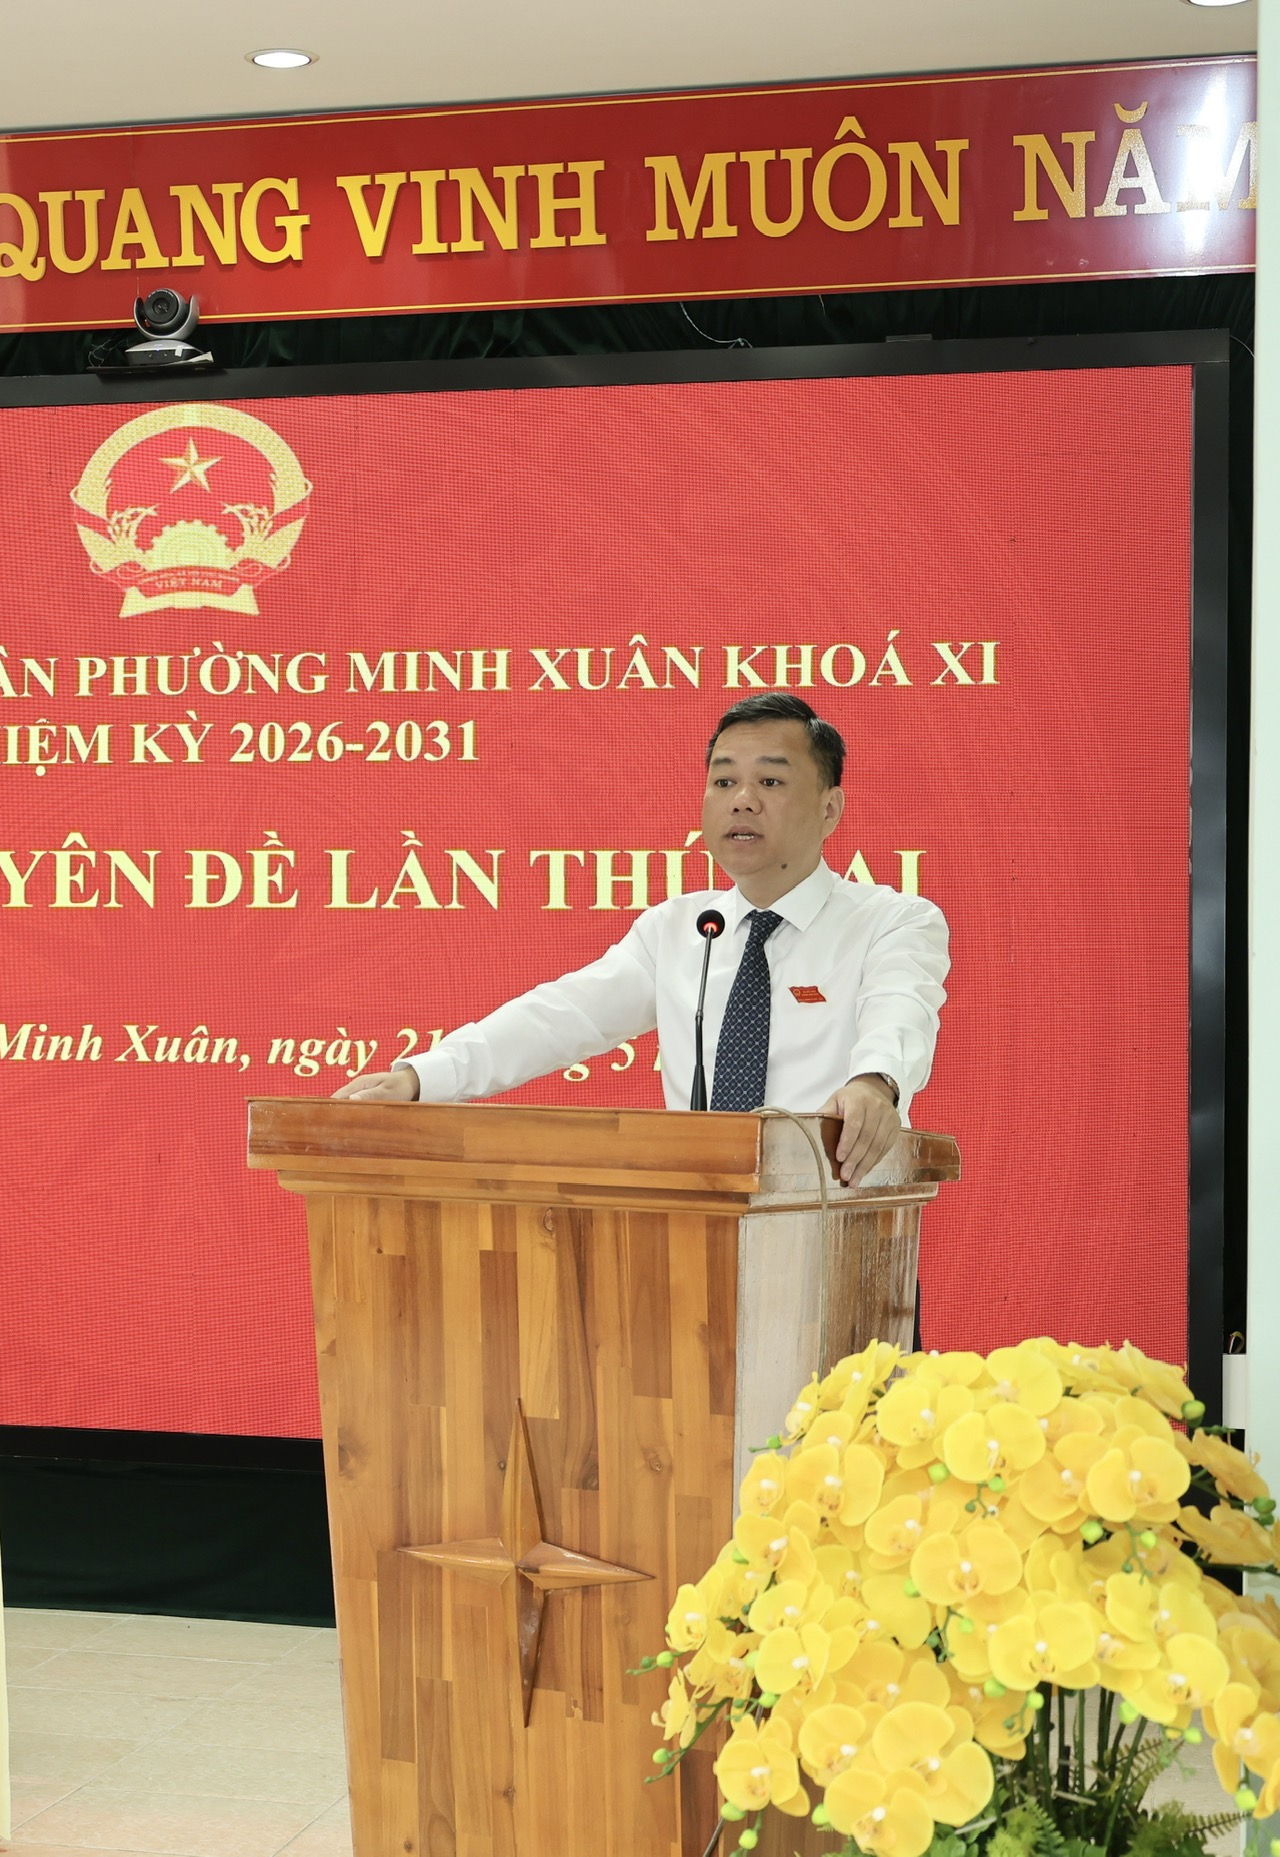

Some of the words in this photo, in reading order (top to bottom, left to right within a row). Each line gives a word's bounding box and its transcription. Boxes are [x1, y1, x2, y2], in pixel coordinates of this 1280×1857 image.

[337, 161, 606, 256] VINH
[645, 117, 968, 241] MUÔN
[1013, 101, 1257, 221] NĂM
[192, 577, 222, 588] NAM
[74, 641, 329, 696] PHƯỜNG
[345, 648, 512, 692] MINH
[528, 634, 704, 690] XUÂN
[722, 630, 913, 688] KHOÁ
[930, 642, 1000, 685] XI
[129, 710, 214, 763] KỲ
[229, 720, 479, 762] 2026-2031
[185, 831, 298, 908] ĐỀ
[324, 830, 505, 910] LẦN
[114, 1025, 250, 1072] Xuân,
[267, 1027, 378, 1077] ngày
